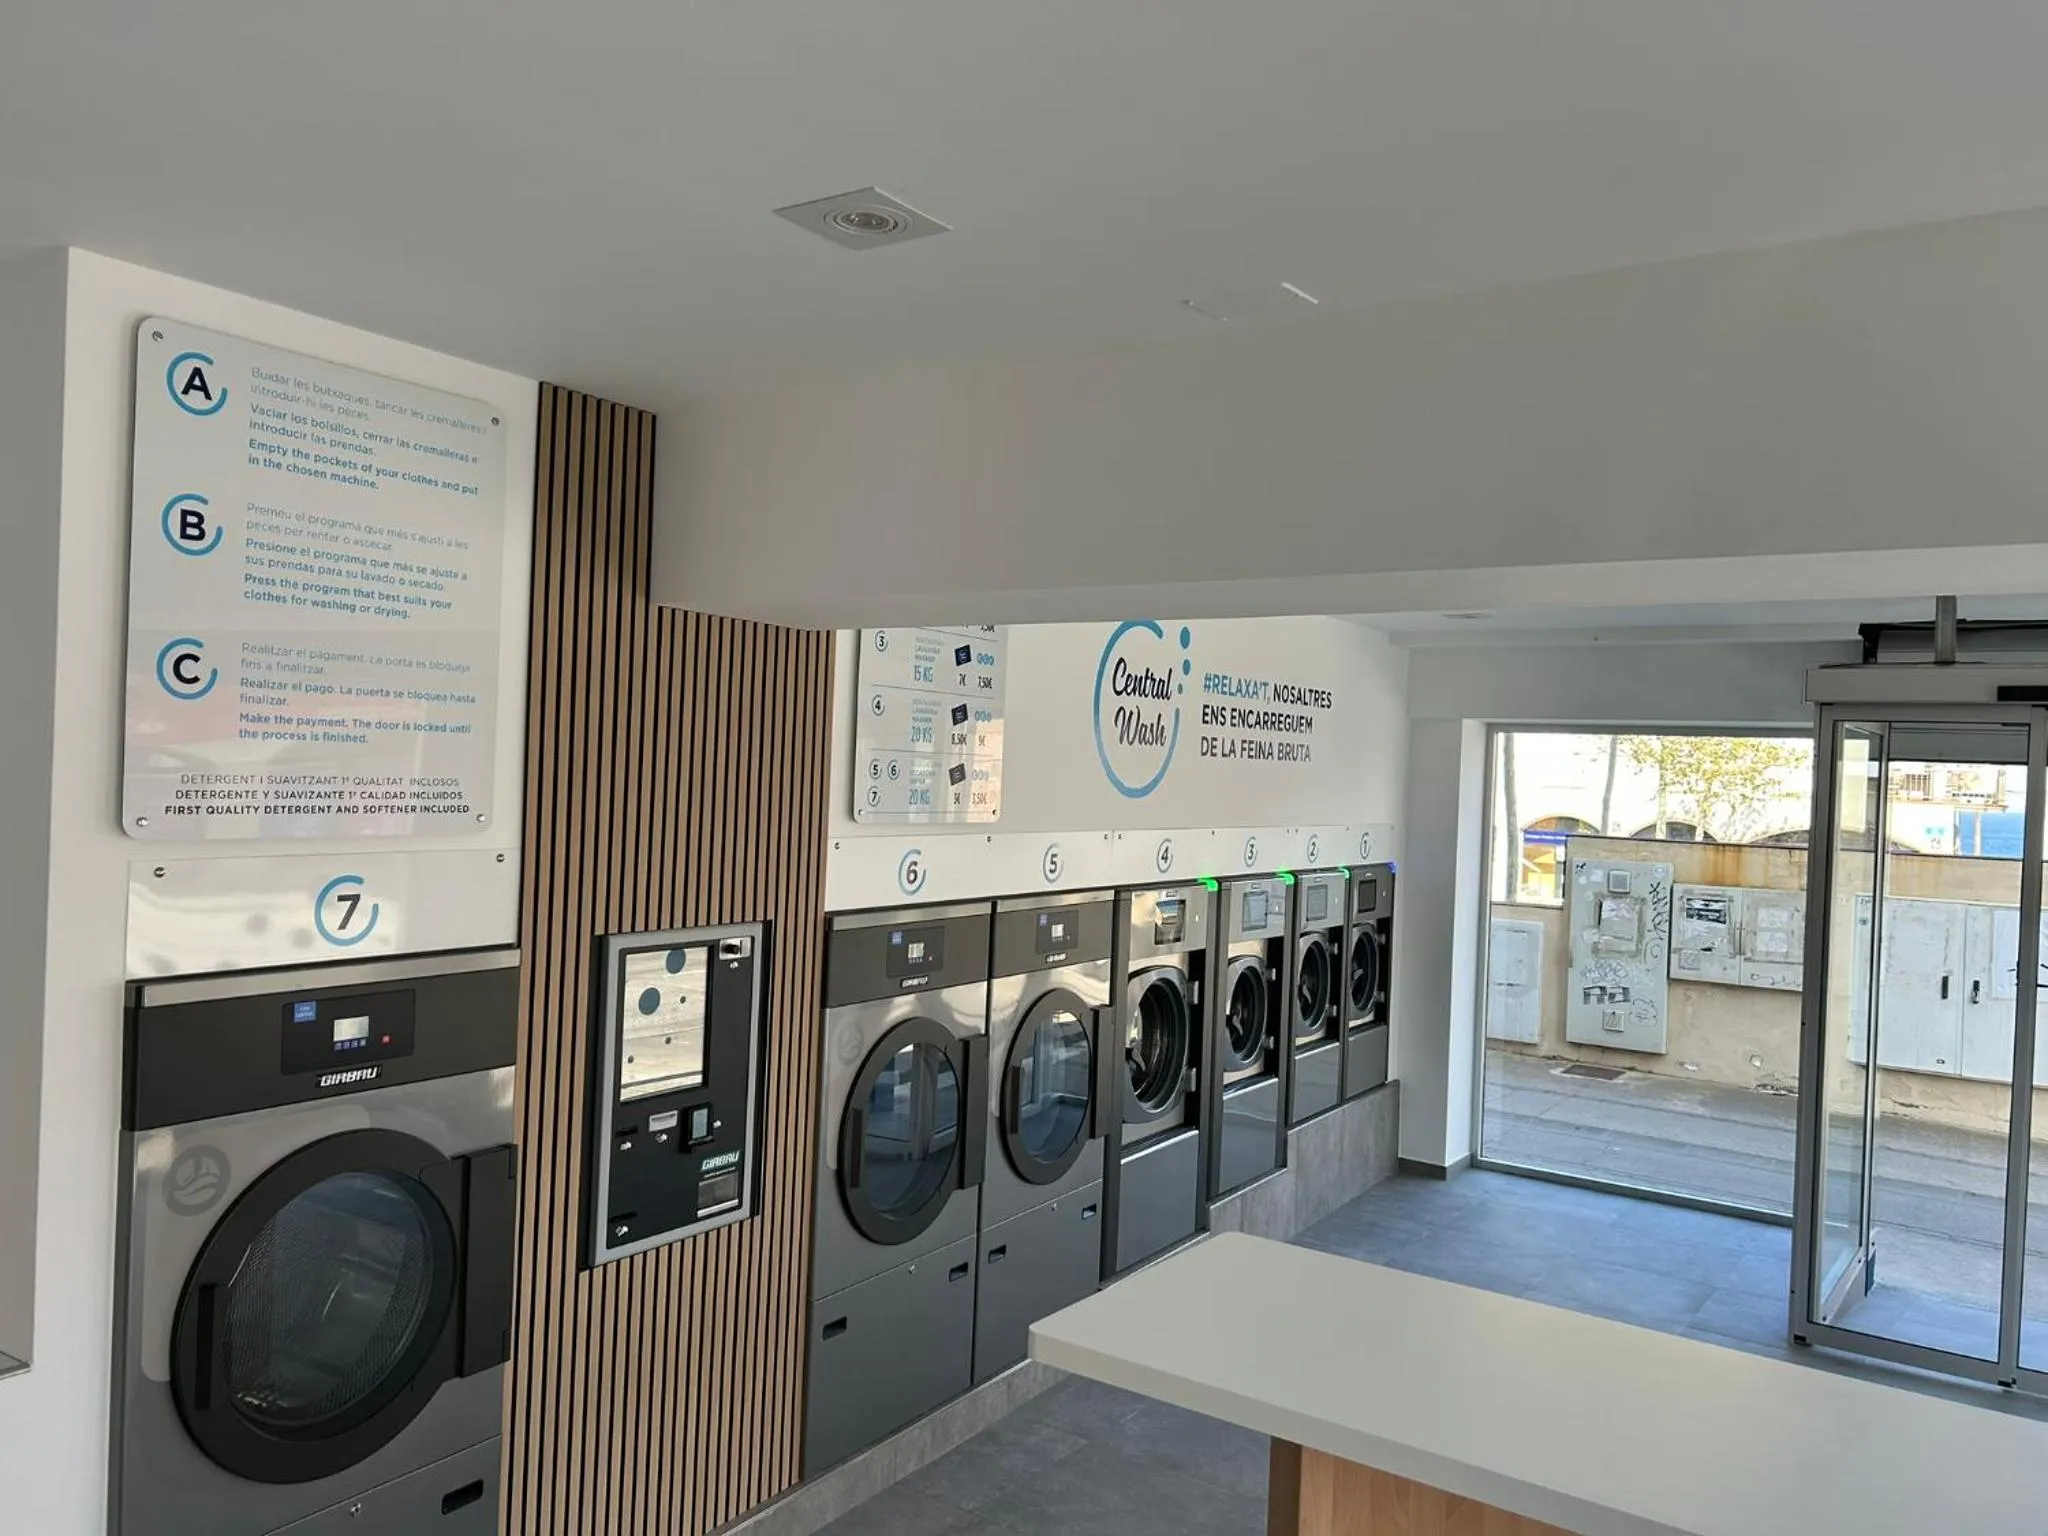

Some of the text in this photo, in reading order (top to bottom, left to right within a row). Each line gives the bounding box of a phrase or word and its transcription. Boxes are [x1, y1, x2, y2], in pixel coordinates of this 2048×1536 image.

[181, 366, 213, 402] A
[251, 366, 291, 385] Buidar
[294, 377, 311, 391] les
[249, 419, 377, 457] introducir las prendas.
[250, 402, 288, 420] Vaciar
[291, 411, 308, 425] los
[363, 430, 394, 445] cerrar
[396, 435, 411, 449] las
[248, 453, 380, 490] in the chosen machine.
[249, 438, 480, 496] Empty the pockets of your clothes and put
[179, 509, 206, 542] B
[247, 502, 292, 520] Premeu
[295, 511, 305, 522] el
[308, 513, 362, 532] programa
[364, 523, 385, 536] que
[246, 520, 281, 534] peces
[284, 526, 304, 537] per
[343, 535, 350, 545] o
[245, 555, 265, 566] sus
[268, 558, 315, 573] prendas
[318, 565, 342, 577] para
[345, 569, 358, 579] su
[361, 570, 395, 584] lavado
[398, 577, 405, 586] o
[246, 537, 468, 581] Presione el programa que más se ajuste a
[244, 572, 452, 610] Press the program that best suits your
[243, 588, 411, 620] clothes for washing or drying.
[878, 635, 885, 647] 3
[241, 642, 295, 658] Realitzar
[296, 648, 306, 658] el
[385, 657, 413, 669] porta
[241, 657, 262, 671] fins
[265, 662, 272, 671] a
[172, 653, 201, 685] C
[914, 665, 933, 682] 15 KG
[1112, 657, 1172, 700] Central
[239, 692, 290, 707] finalizar.
[240, 677, 477, 704] Realizar el pago. La puerta se bloquea hasta
[1273, 683, 1332, 709] NOSALTRES
[875, 700, 881, 711] 4
[239, 712, 472, 734] Make the payment. The door is locked until
[1114, 706, 1167, 747] Wash
[1202, 704, 1313, 734] ENS ENCARREGUEM
[238, 728, 369, 743] the process is finished.
[911, 726, 921, 743] 20
[1201, 736, 1311, 762] DE LA FEINA BRUTA
[179, 773, 460, 787] DETERGENT I SUAVITZANT QUALITAT INCLOSOS
[873, 764, 879, 776] 5
[891, 765, 897, 776] 6
[175, 789, 464, 800] DETERGENTE Y SUAVIZANTE CALIDAD INCLUIDOS
[872, 792, 877, 803] 7
[164, 804, 470, 816] FIRST QUALITY DETERGENT AND SOFTENER INCLUDED
[1160, 849, 1169, 864] 4
[1247, 845, 1254, 860] 3
[1310, 842, 1316, 857] 2
[906, 860, 918, 884] 6
[1049, 853, 1058, 873] 5
[336, 893, 361, 930] 7
[320, 1066, 378, 1088] GIRBAU
[701, 1151, 740, 1171] GIRBAU
